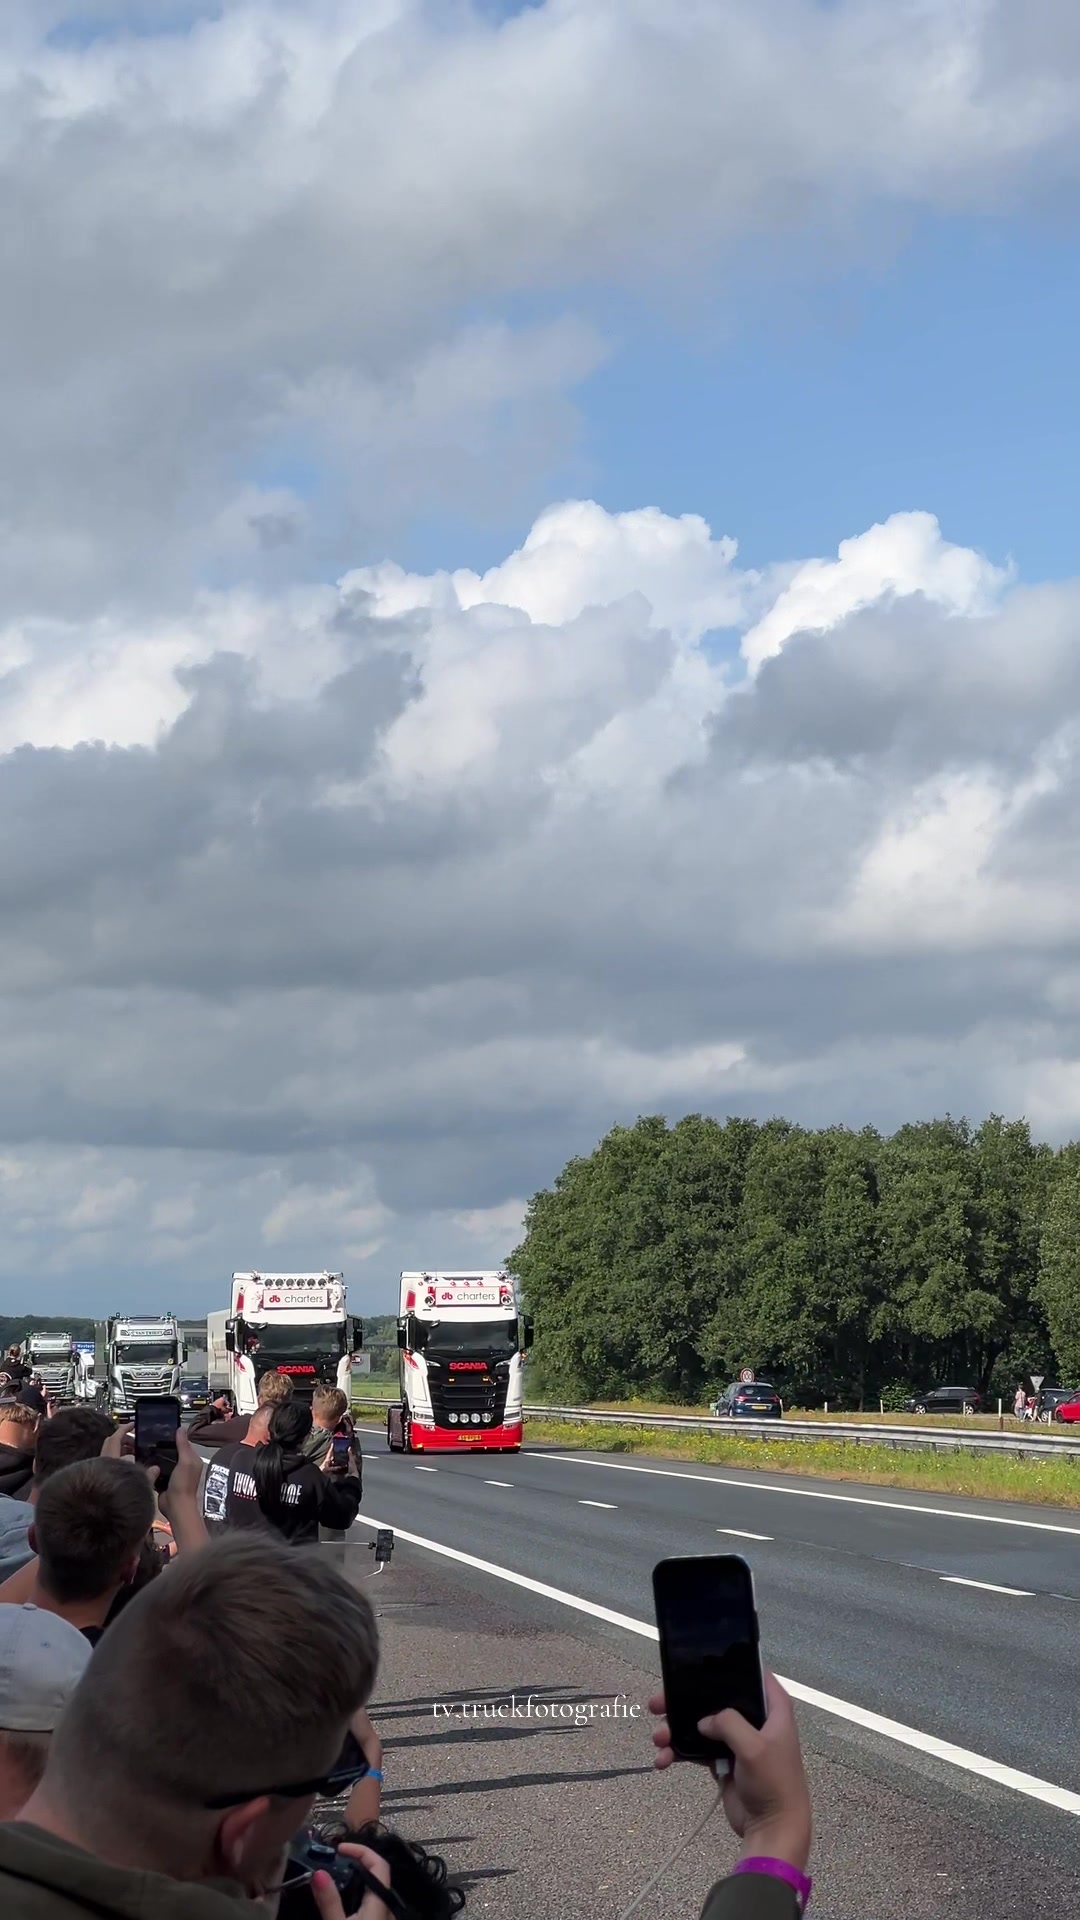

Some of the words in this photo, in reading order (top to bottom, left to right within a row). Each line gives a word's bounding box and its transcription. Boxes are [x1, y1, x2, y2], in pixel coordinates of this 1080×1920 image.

[284, 1294, 324, 1303] charters
[456, 1291, 496, 1300] charters
[276, 1365, 316, 1373] SCANIA
[449, 1362, 488, 1370] SCANIA
